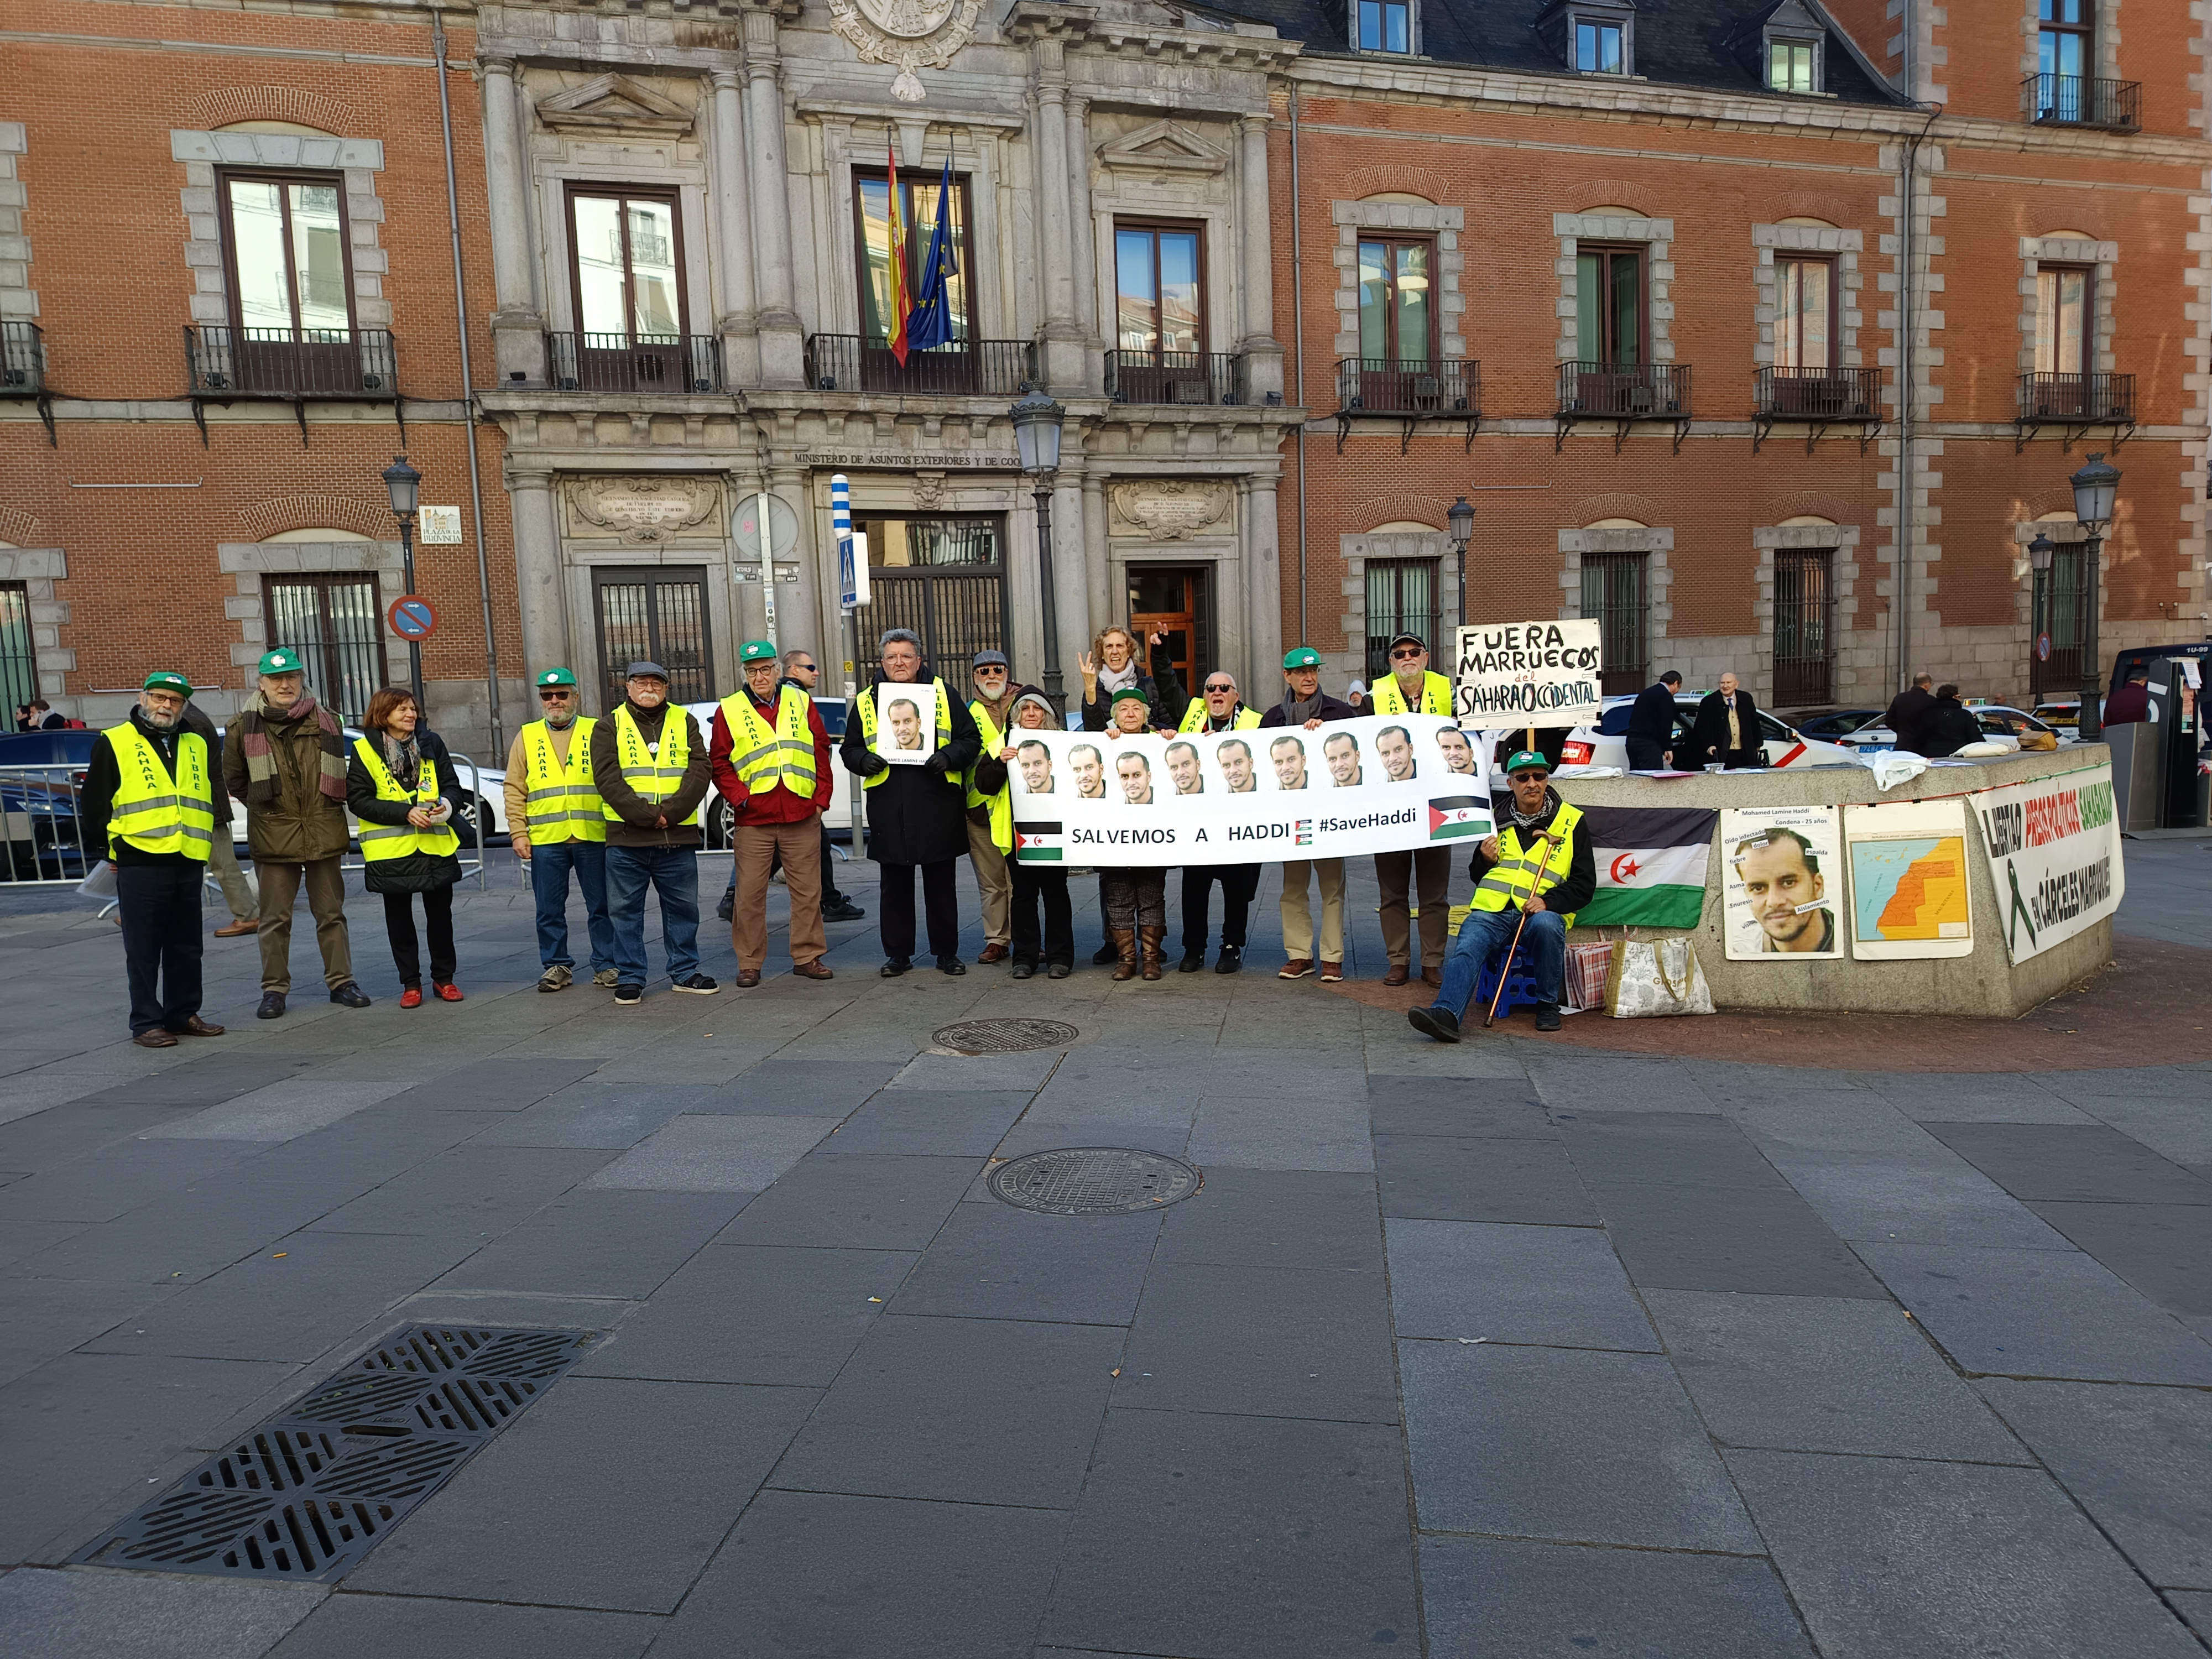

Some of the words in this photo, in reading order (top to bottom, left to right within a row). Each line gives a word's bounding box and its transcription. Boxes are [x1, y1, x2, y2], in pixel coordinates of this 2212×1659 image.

[795, 453, 847, 465] MINISTERIO
[851, 454, 863, 464] DE
[868, 455, 911, 465] ASUNTOS
[914, 455, 971, 466] EXTERIORES
[974, 457, 981, 466] Y
[985, 457, 998, 466] DE
[1462, 624, 1564, 655] FUERA
[1459, 645, 1599, 675] MARRUECOS
[1515, 671, 1538, 682] del
[790, 701, 799, 738] LIBRE
[864, 694, 873, 733] SAHARA
[1187, 705, 1206, 733] SAHAR
[1428, 691, 1437, 713] LIB
[743, 708, 761, 747] SAHARA
[538, 738, 547, 779] SAHARA
[625, 727, 639, 765] SAHARA
[134, 743, 157, 790] SAHARA
[190, 746, 200, 791] LIBRE
[1073, 829, 1175, 843] SALVEMOS
[1196, 828, 1208, 842] A
[1229, 823, 1288, 841] HADDI
[1320, 808, 1415, 832] #SaveHaddi
[1549, 818, 1572, 862] LIBRE
[1724, 836, 1739, 844] Oído
[1739, 830, 1766, 840] infectado
[1982, 803, 2021, 858] LIBERTAD
[1729, 856, 1746, 864] fiebre
[1730, 898, 1753, 908] Enuresis
[1797, 899, 1830, 912] Aislamiento
[2031, 896, 2043, 932] EN
[2039, 867, 2079, 928] CÁRCELES
